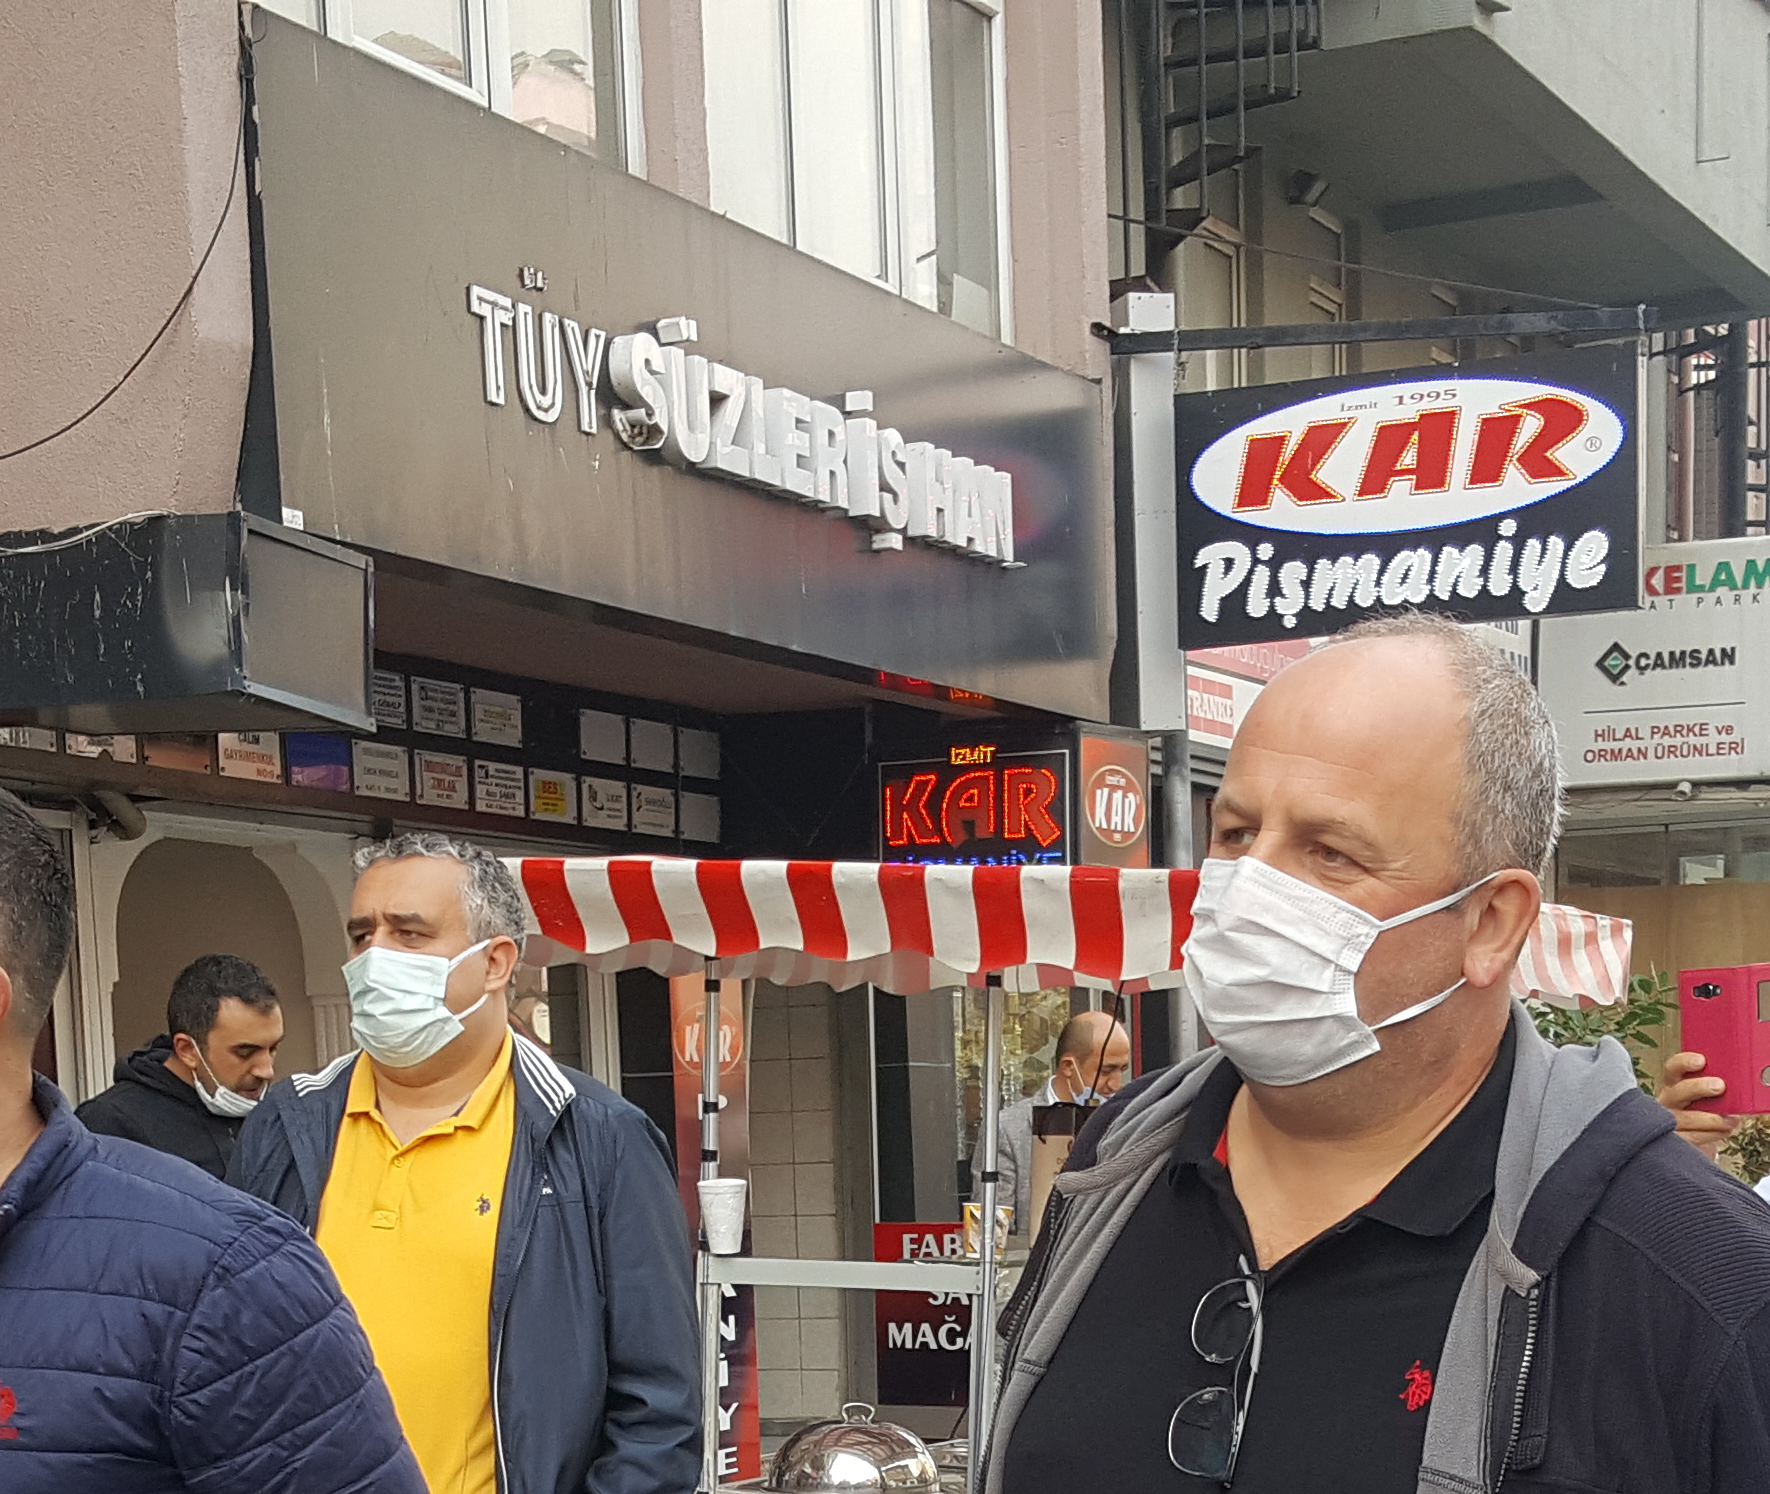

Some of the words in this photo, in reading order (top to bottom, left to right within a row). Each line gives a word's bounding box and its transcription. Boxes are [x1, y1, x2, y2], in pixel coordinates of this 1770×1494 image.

[1340, 401, 1378, 413] İzmit
[1392, 388, 1458, 407] 1995
[1232, 393, 1590, 513] KAR
[1192, 518, 1610, 630] Pişmaniye
[1635, 647, 1737, 675] ÇAMSAN
[1583, 746, 1649, 764] ORMAN
[1653, 738, 1746, 759] ÜRÜNLERİ
[1594, 725, 1645, 743] HİLAL
[1650, 723, 1710, 740] PARKE
[1715, 724, 1735, 736] ve
[884, 767, 1062, 848] KAR
[1095, 787, 1136, 833] KAR
